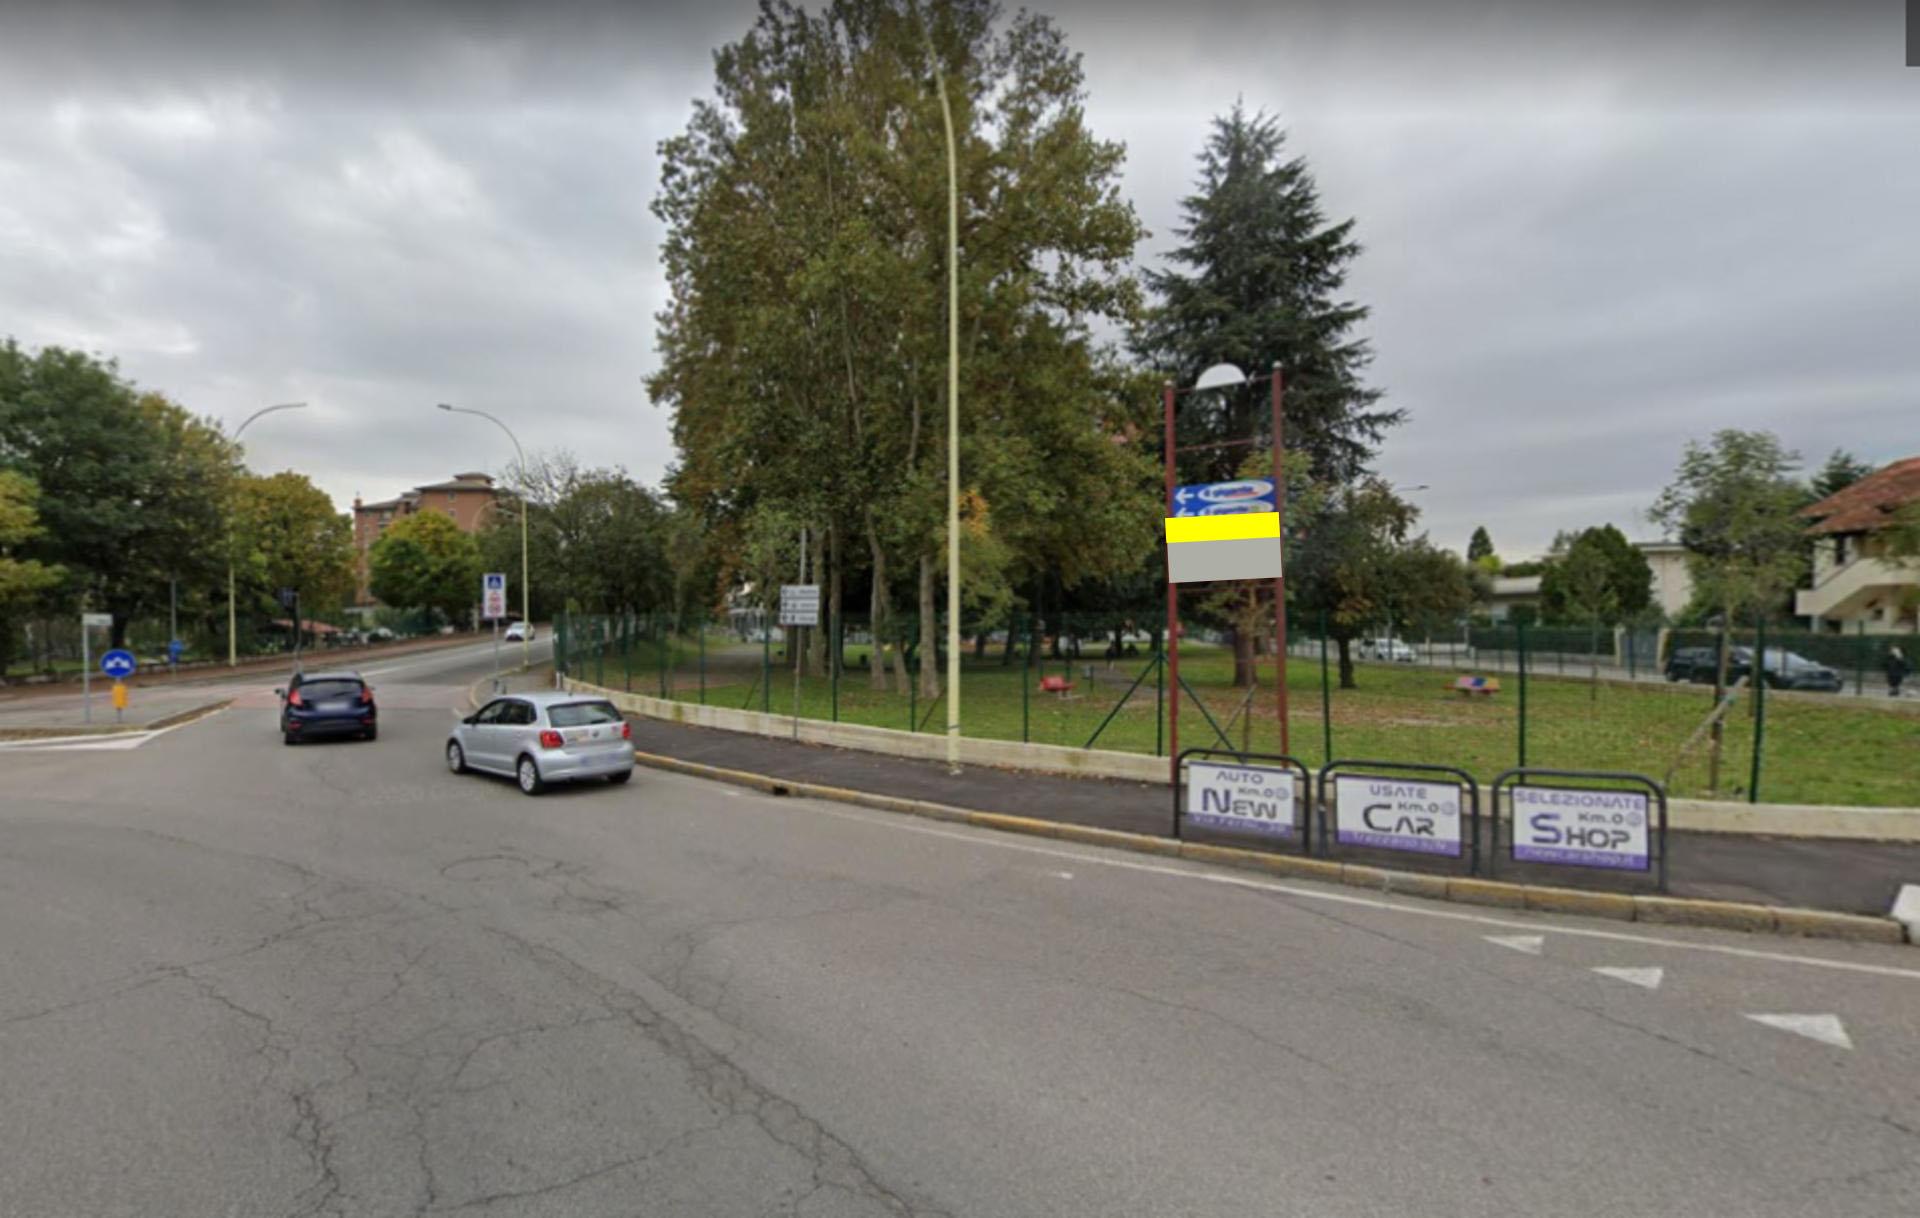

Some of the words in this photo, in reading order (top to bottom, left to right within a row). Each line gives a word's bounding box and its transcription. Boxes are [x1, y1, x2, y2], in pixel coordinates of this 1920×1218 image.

[1216, 771, 1264, 784] AUTO
[1202, 787, 1277, 819] NEW
[1369, 784, 1427, 799] USATE
[1515, 790, 1644, 810] SELEZIONATE
[1362, 803, 1435, 836] CAR
[1530, 812, 1631, 849] SHOP
